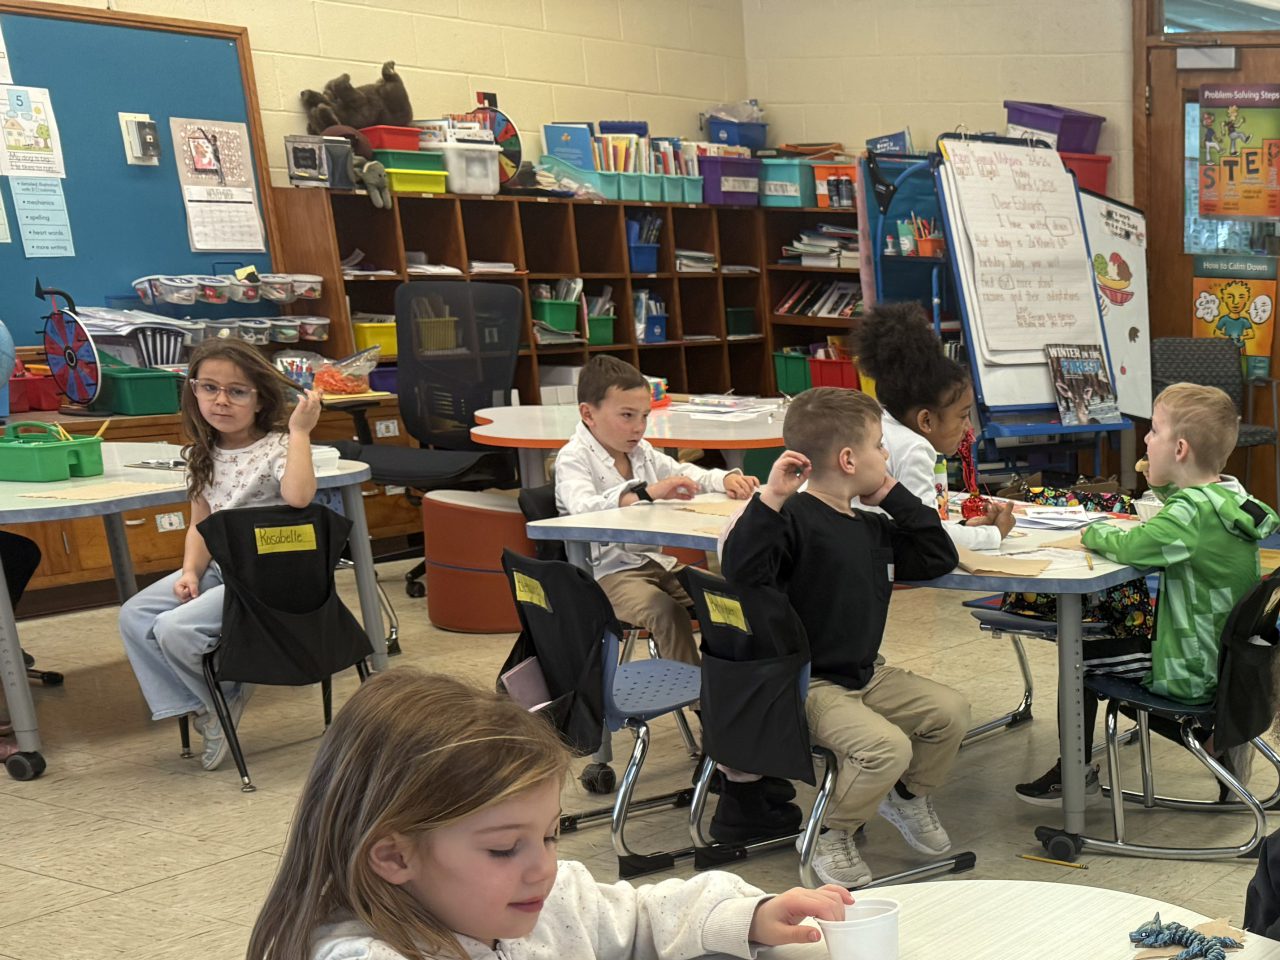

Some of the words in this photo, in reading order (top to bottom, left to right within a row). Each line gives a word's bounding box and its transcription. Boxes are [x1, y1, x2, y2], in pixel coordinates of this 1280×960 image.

[16, 95, 24, 107] 5
[1204, 91, 1260, 101] Problem-Solving
[1261, 91, 1280, 100] Steps
[30, 214, 50, 222] spelling
[1203, 262, 1219, 270] How
[1049, 347, 1080, 358] WINTER
[1061, 360, 1101, 373] FOREST
